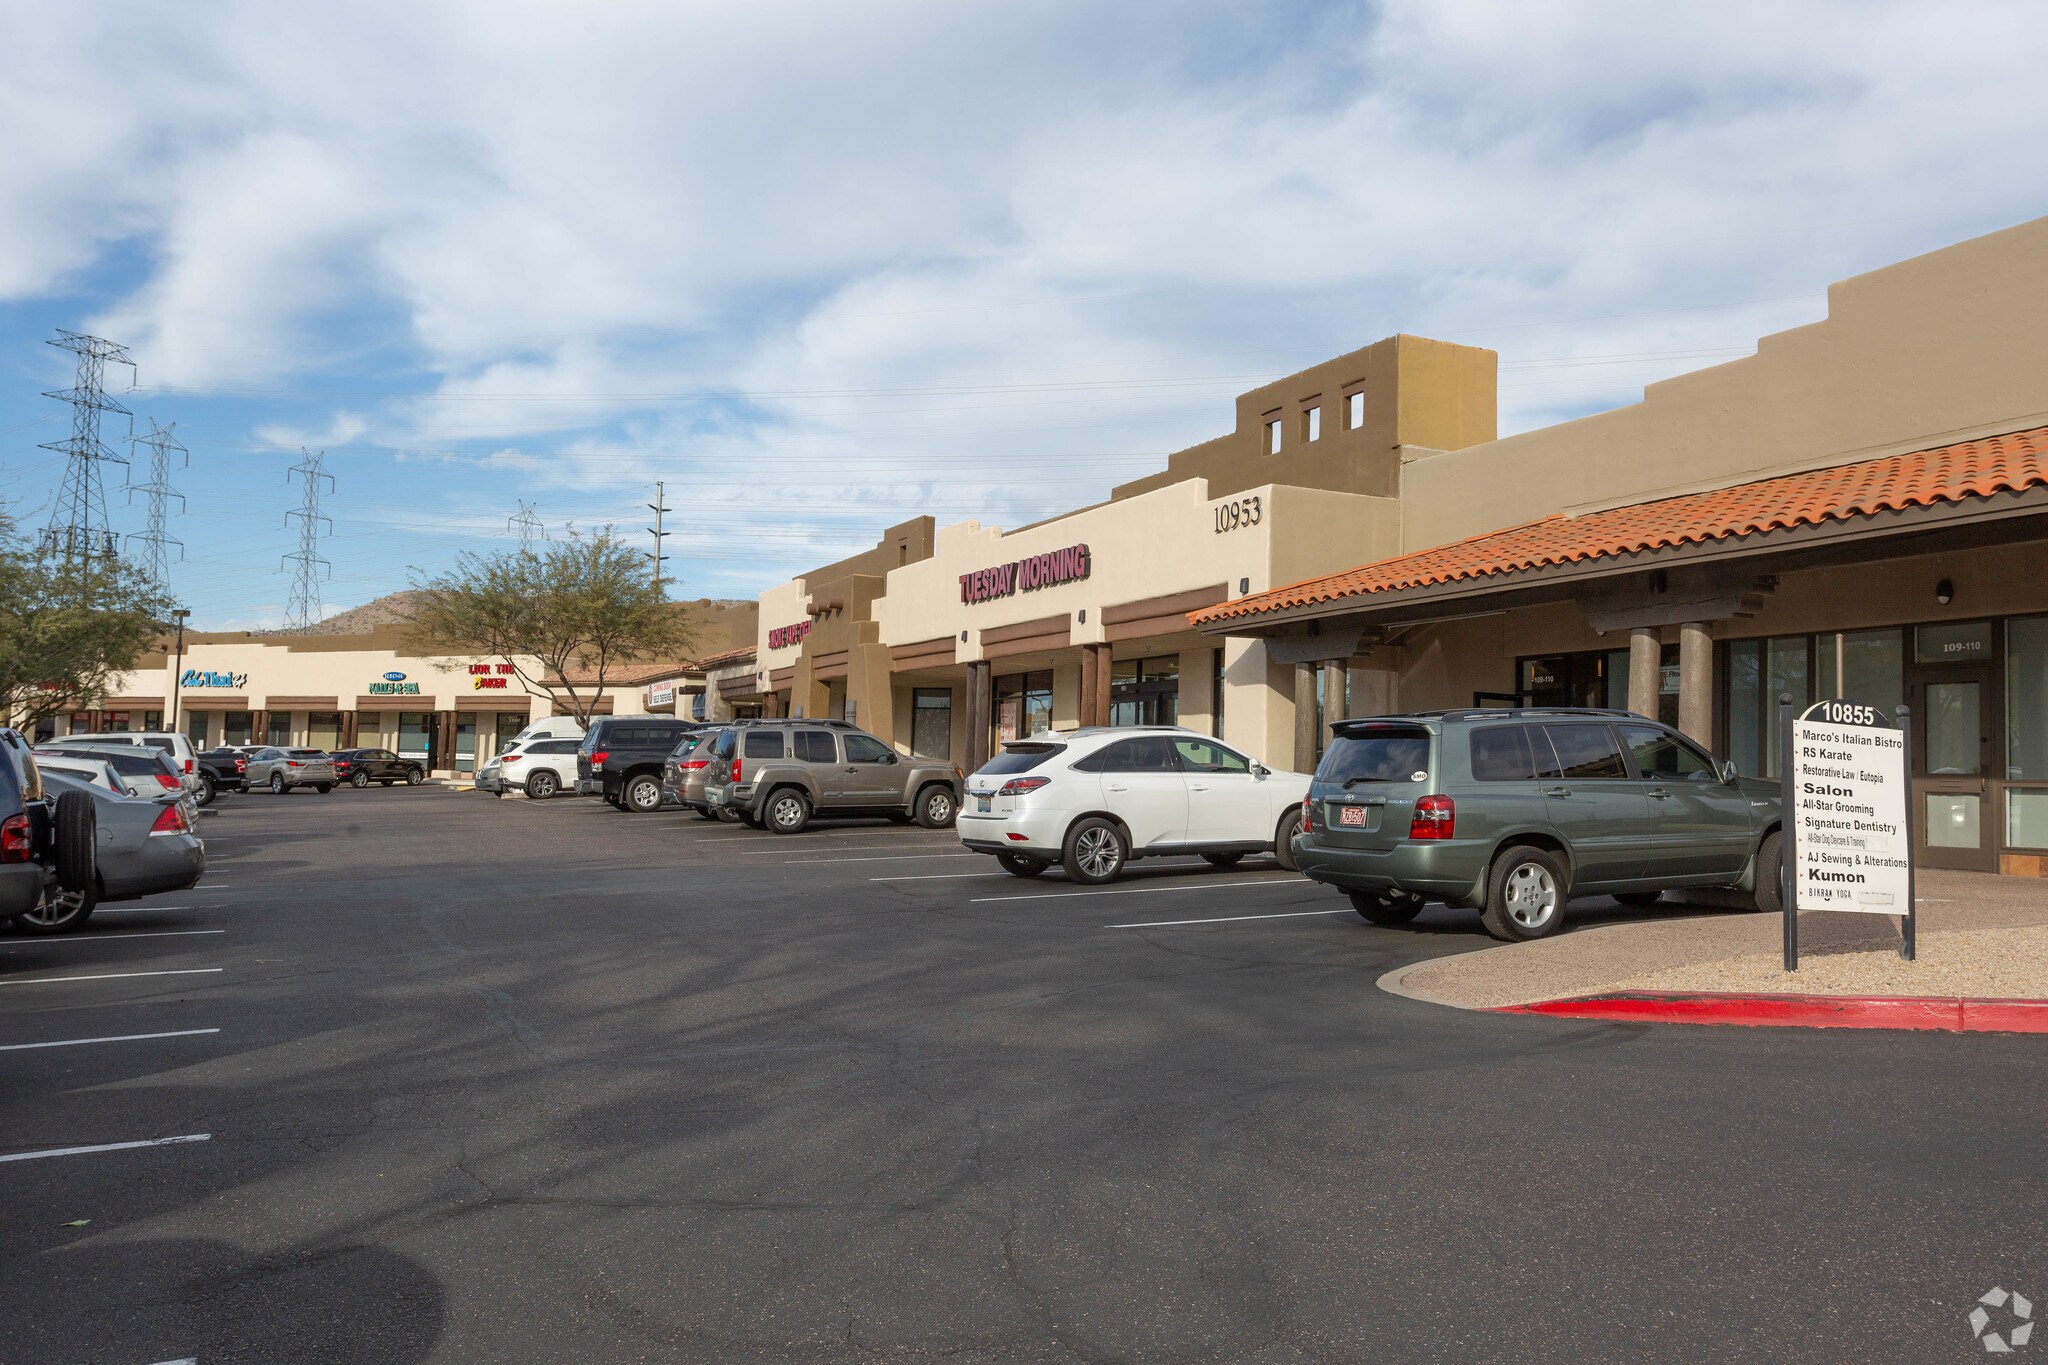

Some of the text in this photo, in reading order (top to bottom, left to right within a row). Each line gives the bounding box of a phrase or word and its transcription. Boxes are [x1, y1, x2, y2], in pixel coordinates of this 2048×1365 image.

[1214, 496, 1263, 534] 10953
[959, 543, 1091, 606] TUESDAY MORNING
[1944, 641, 1981, 652] 109-110
[203, 671, 233, 688] Thai
[474, 675, 507, 690] BAKER
[369, 683, 395, 694] NAILS
[404, 683, 420, 694] SPA
[1823, 702, 1874, 725] 10855
[1802, 729, 1903, 748] Marco's Italian Bistro
[1803, 747, 1852, 761] RS Karate
[1803, 764, 1840, 778] Restorative
[1842, 768, 1855, 780] Law
[1860, 770, 1883, 785] Eutopia
[1803, 783, 1853, 797] Salon
[1803, 799, 1874, 817] All-Star Grooming
[1805, 816, 1897, 835] Signature Dentistry
[1807, 852, 1907, 868] AJ Sewing & Alterations
[1808, 868, 1865, 883] Kumon
[1836, 889, 1852, 899] YOGA
